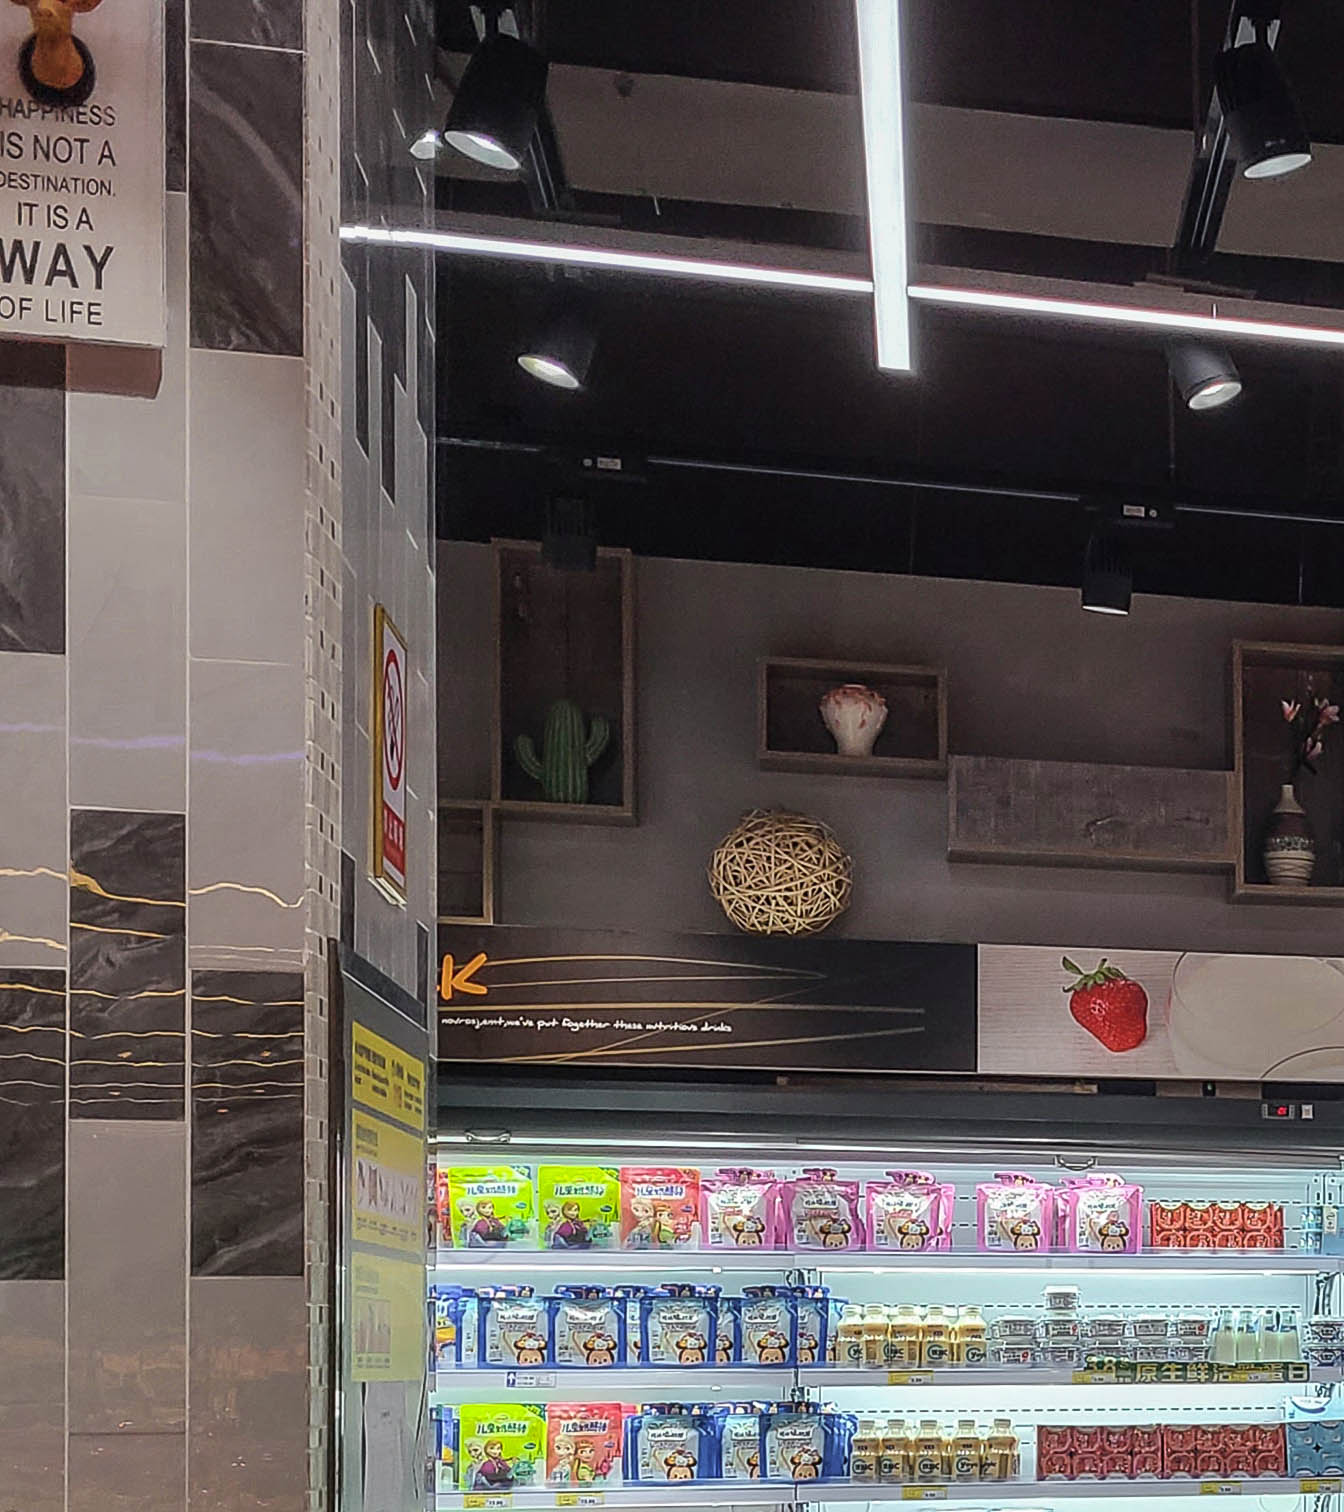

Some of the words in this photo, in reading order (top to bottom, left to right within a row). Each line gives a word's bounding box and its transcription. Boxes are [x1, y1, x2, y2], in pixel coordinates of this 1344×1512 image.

[0, 97, 116, 126] HAPPINESS
[0, 134, 23, 159] IS
[33, 136, 89, 165] NOT
[98, 141, 116, 167] A
[17, 202, 38, 226] IT
[47, 204, 68, 229] IS
[76, 207, 94, 232] A
[0, 239, 115, 291] WAY
[0, 297, 31, 320] OF
[45, 299, 103, 325] LIFE
[537, 1018, 559, 1030] put
